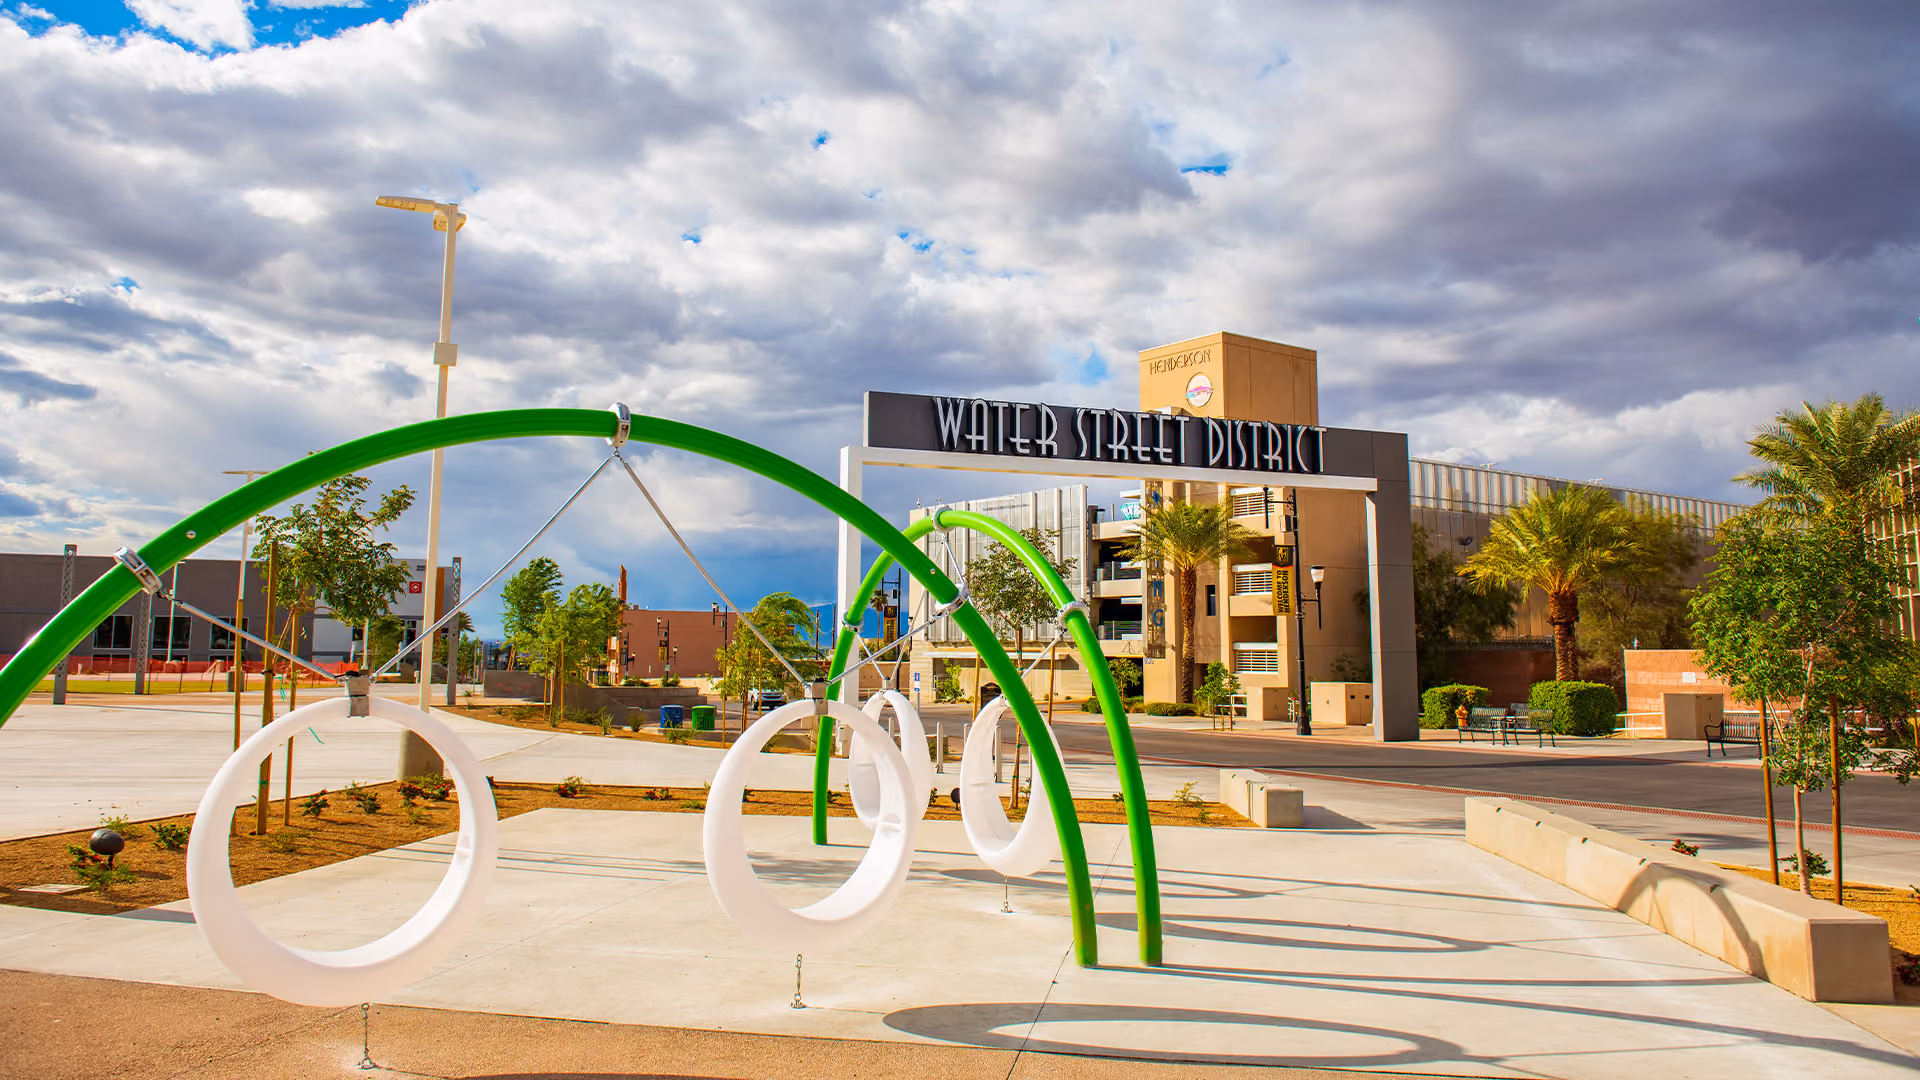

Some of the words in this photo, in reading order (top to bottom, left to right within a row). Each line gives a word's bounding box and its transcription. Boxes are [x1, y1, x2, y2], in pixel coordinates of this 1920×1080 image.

[1149, 348, 1211, 376] HENDERSON
[934, 397, 1058, 456] WATER
[1075, 407, 1190, 465] STREET
[1207, 416, 1327, 473] DISTRICT
[1276, 569, 1282, 579] TO
[1276, 580, 1284, 613] WELCOME
[1282, 570, 1290, 613] HENDERSON
